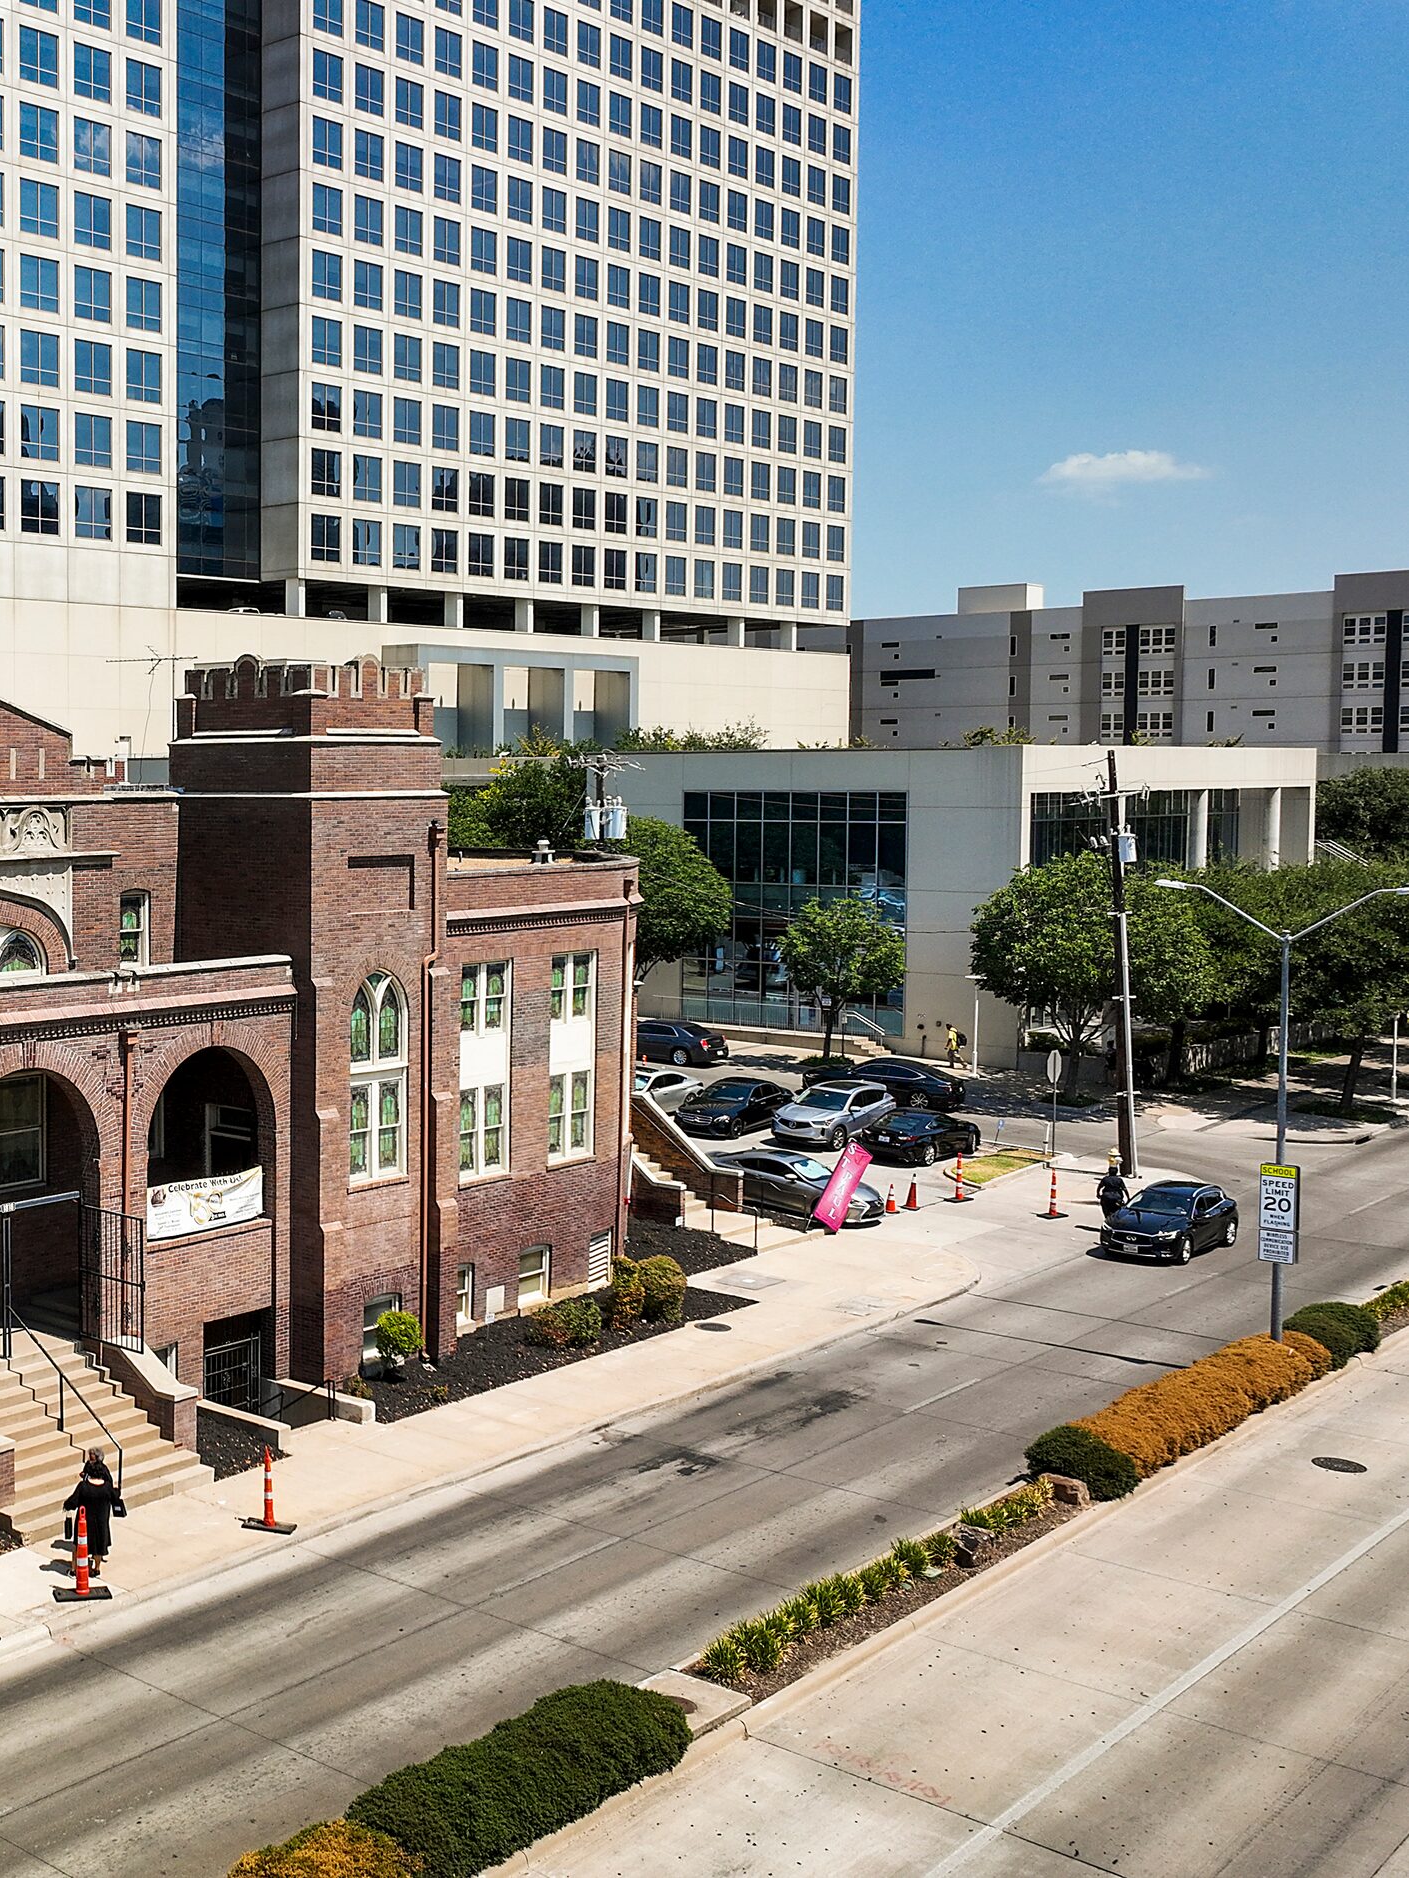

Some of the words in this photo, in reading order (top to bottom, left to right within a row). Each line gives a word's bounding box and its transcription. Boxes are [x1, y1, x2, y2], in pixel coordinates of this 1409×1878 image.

[1262, 1166, 1295, 1177] SCHOOL
[168, 1181, 208, 1193] Celebrate
[209, 1177, 228, 1187] With
[1262, 1179, 1295, 1189] SPEED
[1265, 1188, 1290, 1197] LIMIT
[1263, 1196, 1292, 1213] 20
[1263, 1219, 1291, 1228] FLASHING
[1260, 1236, 1293, 1246] COMMUNICATION
[1263, 1248, 1290, 1257] PROHIBITED
